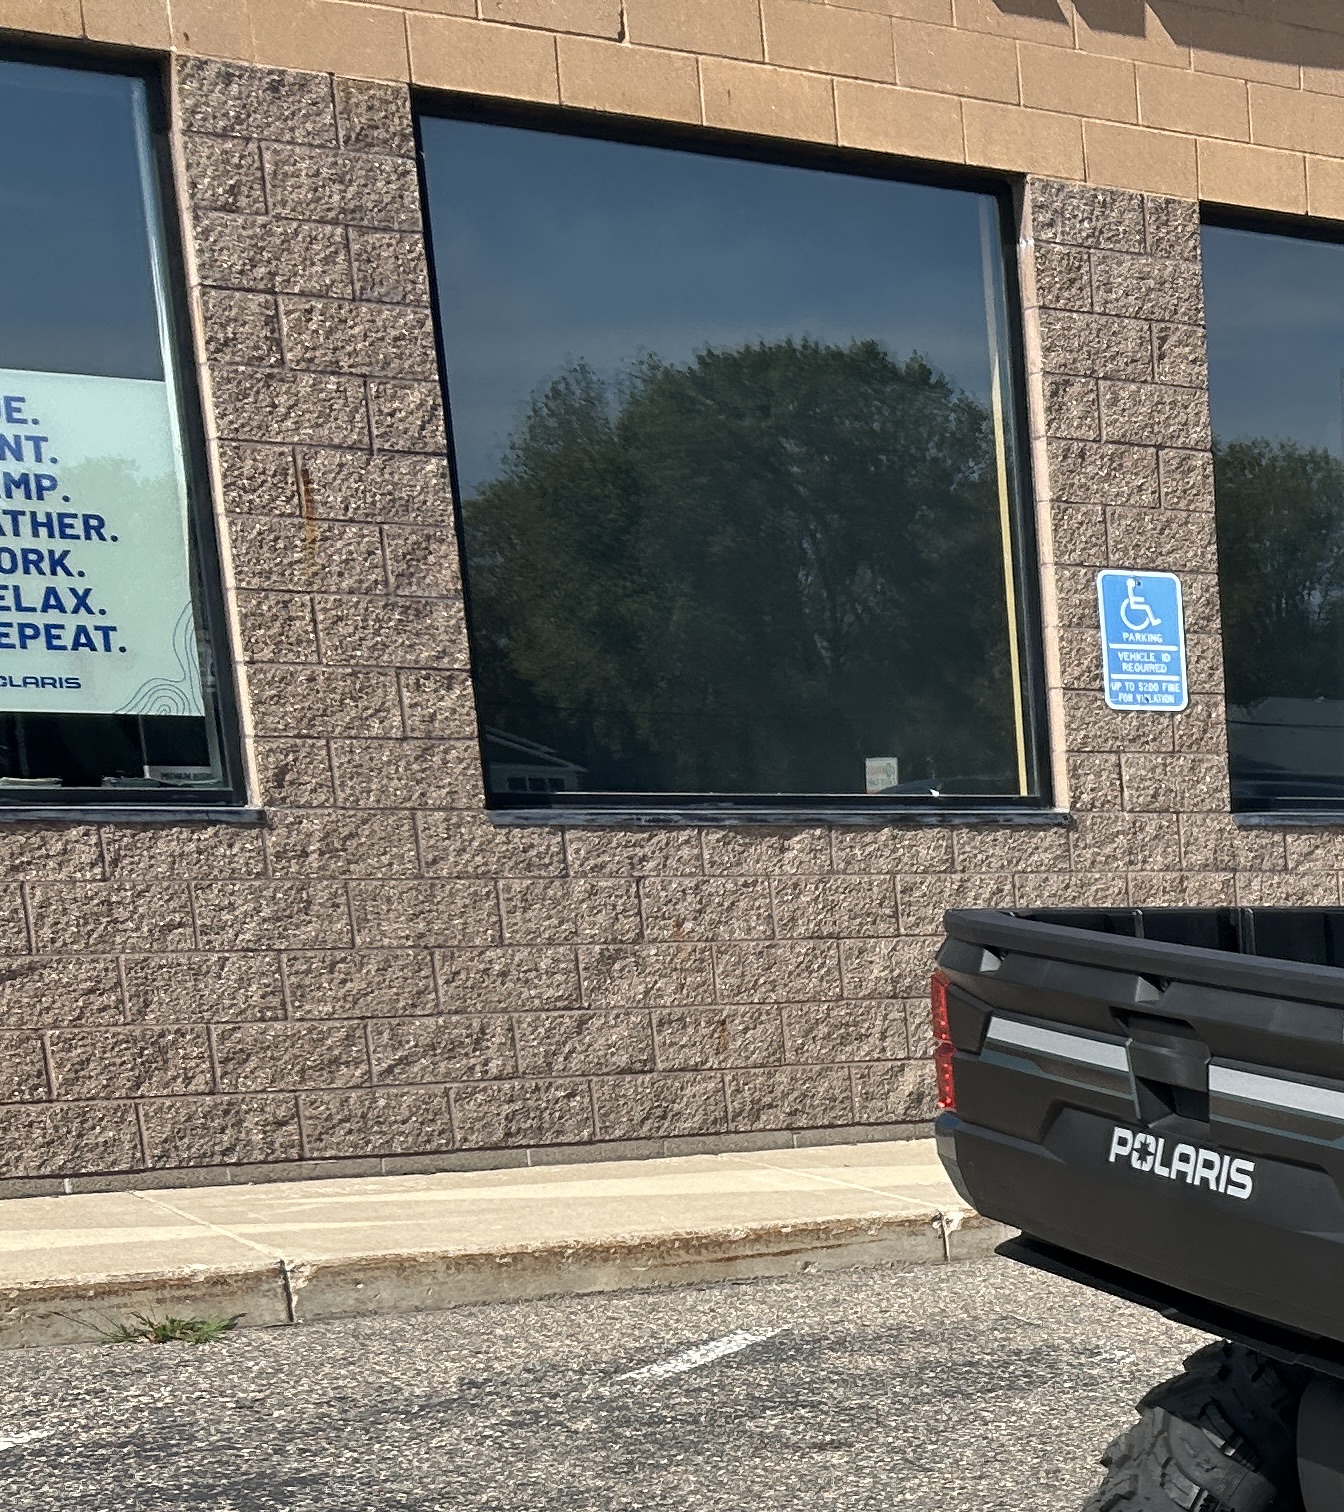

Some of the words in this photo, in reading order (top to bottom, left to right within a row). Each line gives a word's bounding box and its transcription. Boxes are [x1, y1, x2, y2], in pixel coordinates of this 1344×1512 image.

[0, 395, 40, 426] E.
[0, 471, 70, 503] MP.
[1122, 632, 1164, 644] PARKING
[1118, 651, 1157, 662] VEHICLE
[1161, 653, 1172, 663] ID
[1122, 662, 1168, 674] REQUIRED
[1110, 681, 1122, 691] UP
[1125, 681, 1136, 692] TO
[1162, 682, 1181, 693] FINE
[1118, 692, 1134, 703] FOR
[1136, 693, 1176, 704] VIOLATION
[1108, 1126, 1256, 1200] POLARIS
